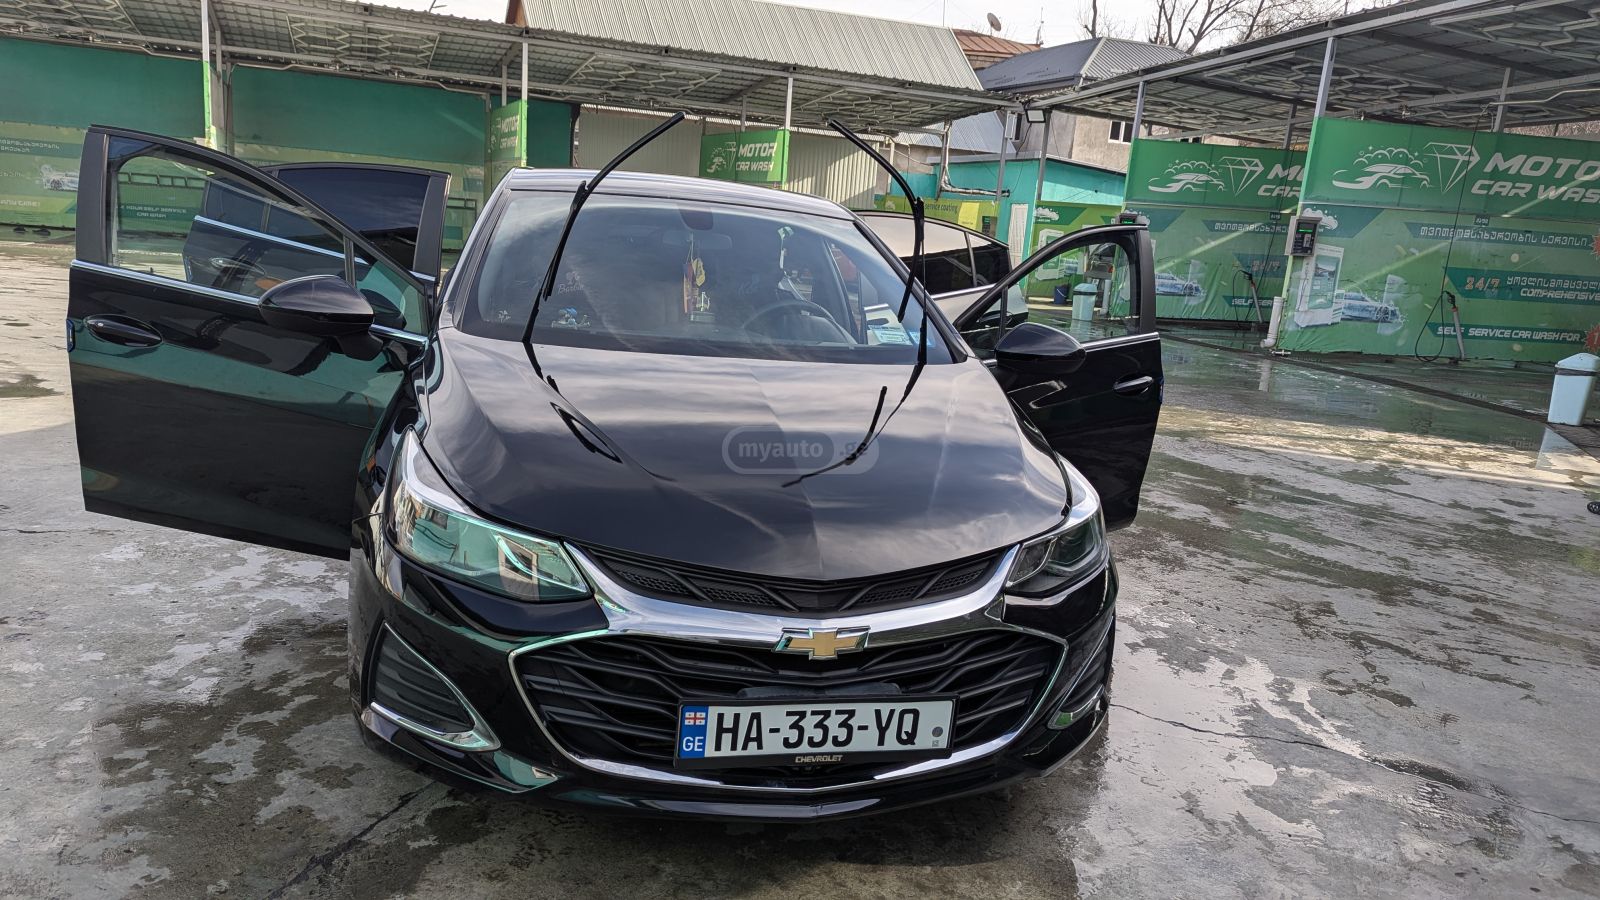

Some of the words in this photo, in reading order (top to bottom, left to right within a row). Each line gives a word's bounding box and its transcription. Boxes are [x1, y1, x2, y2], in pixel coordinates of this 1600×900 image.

[737, 142, 778, 158] MOTOR
[735, 161, 750, 171] CAR
[750, 161, 775, 172] WASH
[1471, 179, 1533, 198] CAR
[1537, 184, 1600, 204] WAS
[1465, 276, 1500, 291] 24/7
[1507, 276, 1600, 291] ყოვლისმომცველ
[1437, 326, 1464, 336] SELF
[1468, 327, 1511, 338] SERVICE
[1512, 329, 1533, 339] CAR
[1533, 331, 1560, 341] WASH
[1560, 332, 1580, 342] FOR
[682, 736, 705, 752] GE
[714, 708, 921, 752] HA-333-YQ
[795, 754, 843, 763] CHEVROLET
